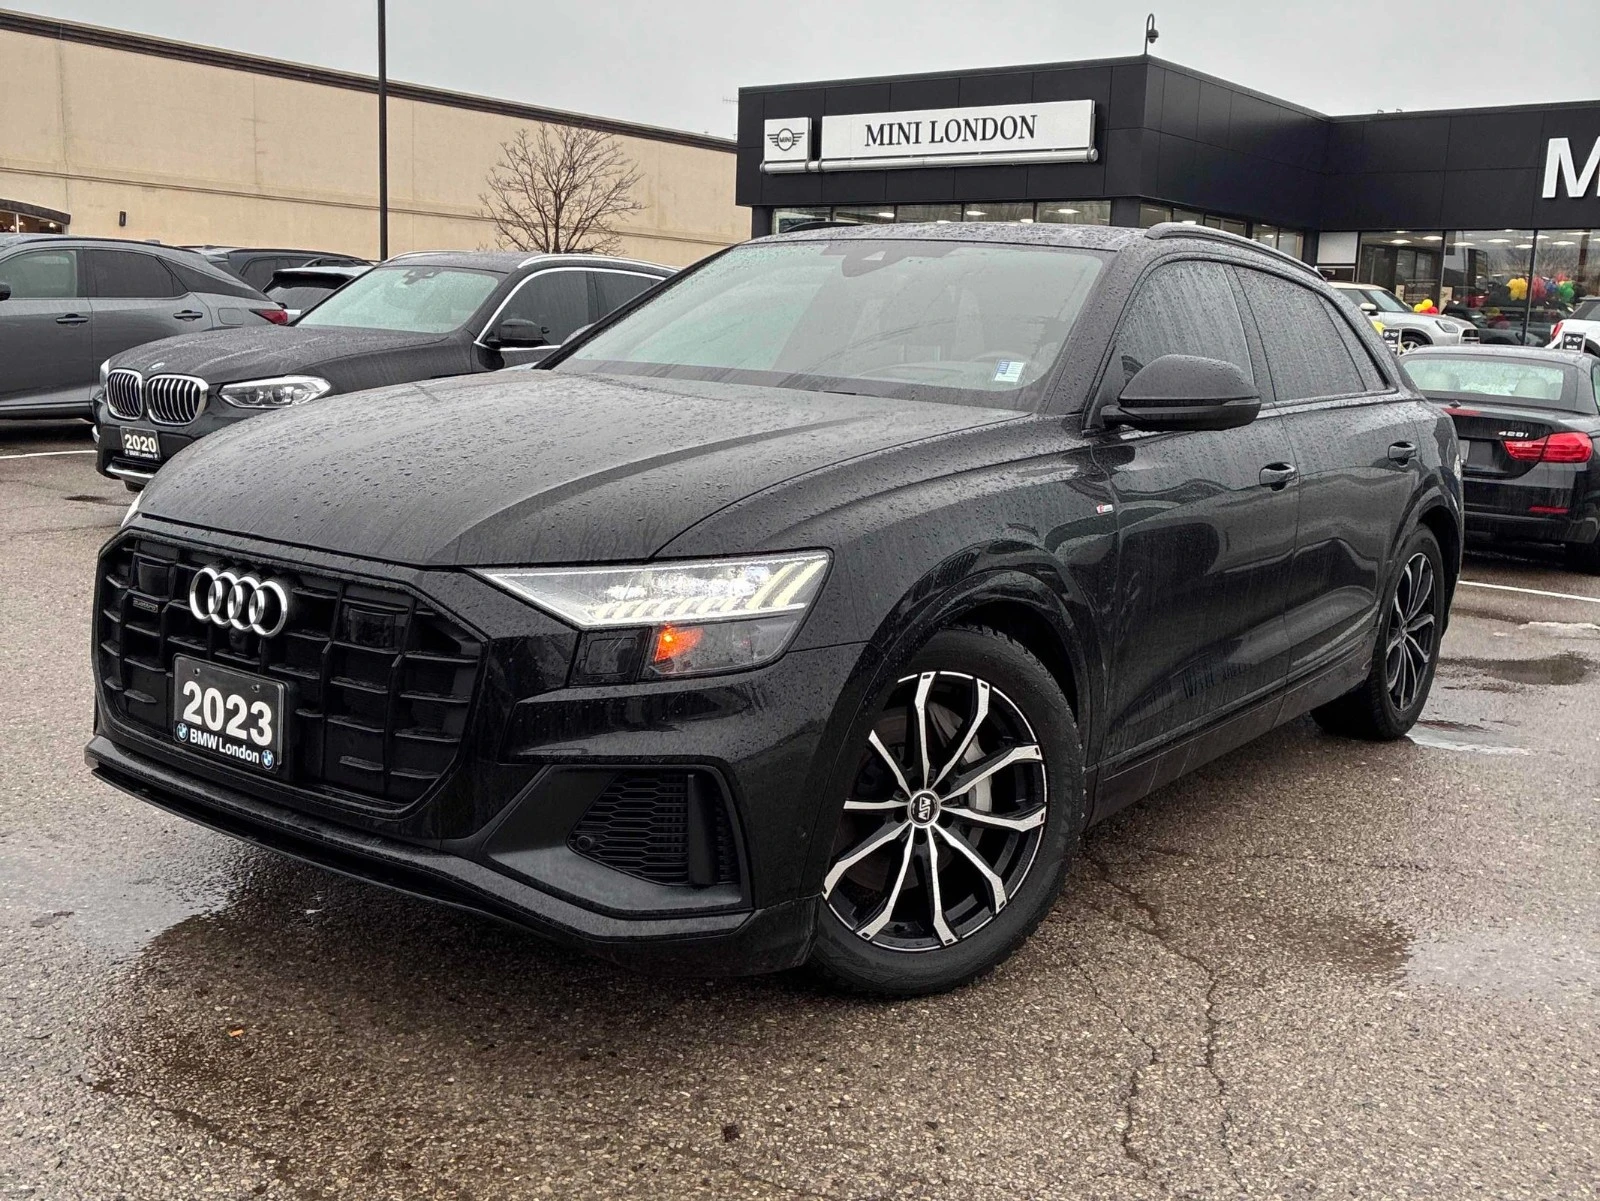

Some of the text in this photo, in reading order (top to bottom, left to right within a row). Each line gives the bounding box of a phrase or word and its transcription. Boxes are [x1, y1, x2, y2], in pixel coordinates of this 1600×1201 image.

[865, 115, 1038, 147] MINI LONDON
[124, 434, 157, 453] 2020
[182, 680, 273, 746] 2023
[189, 729, 260, 764] BMW London
